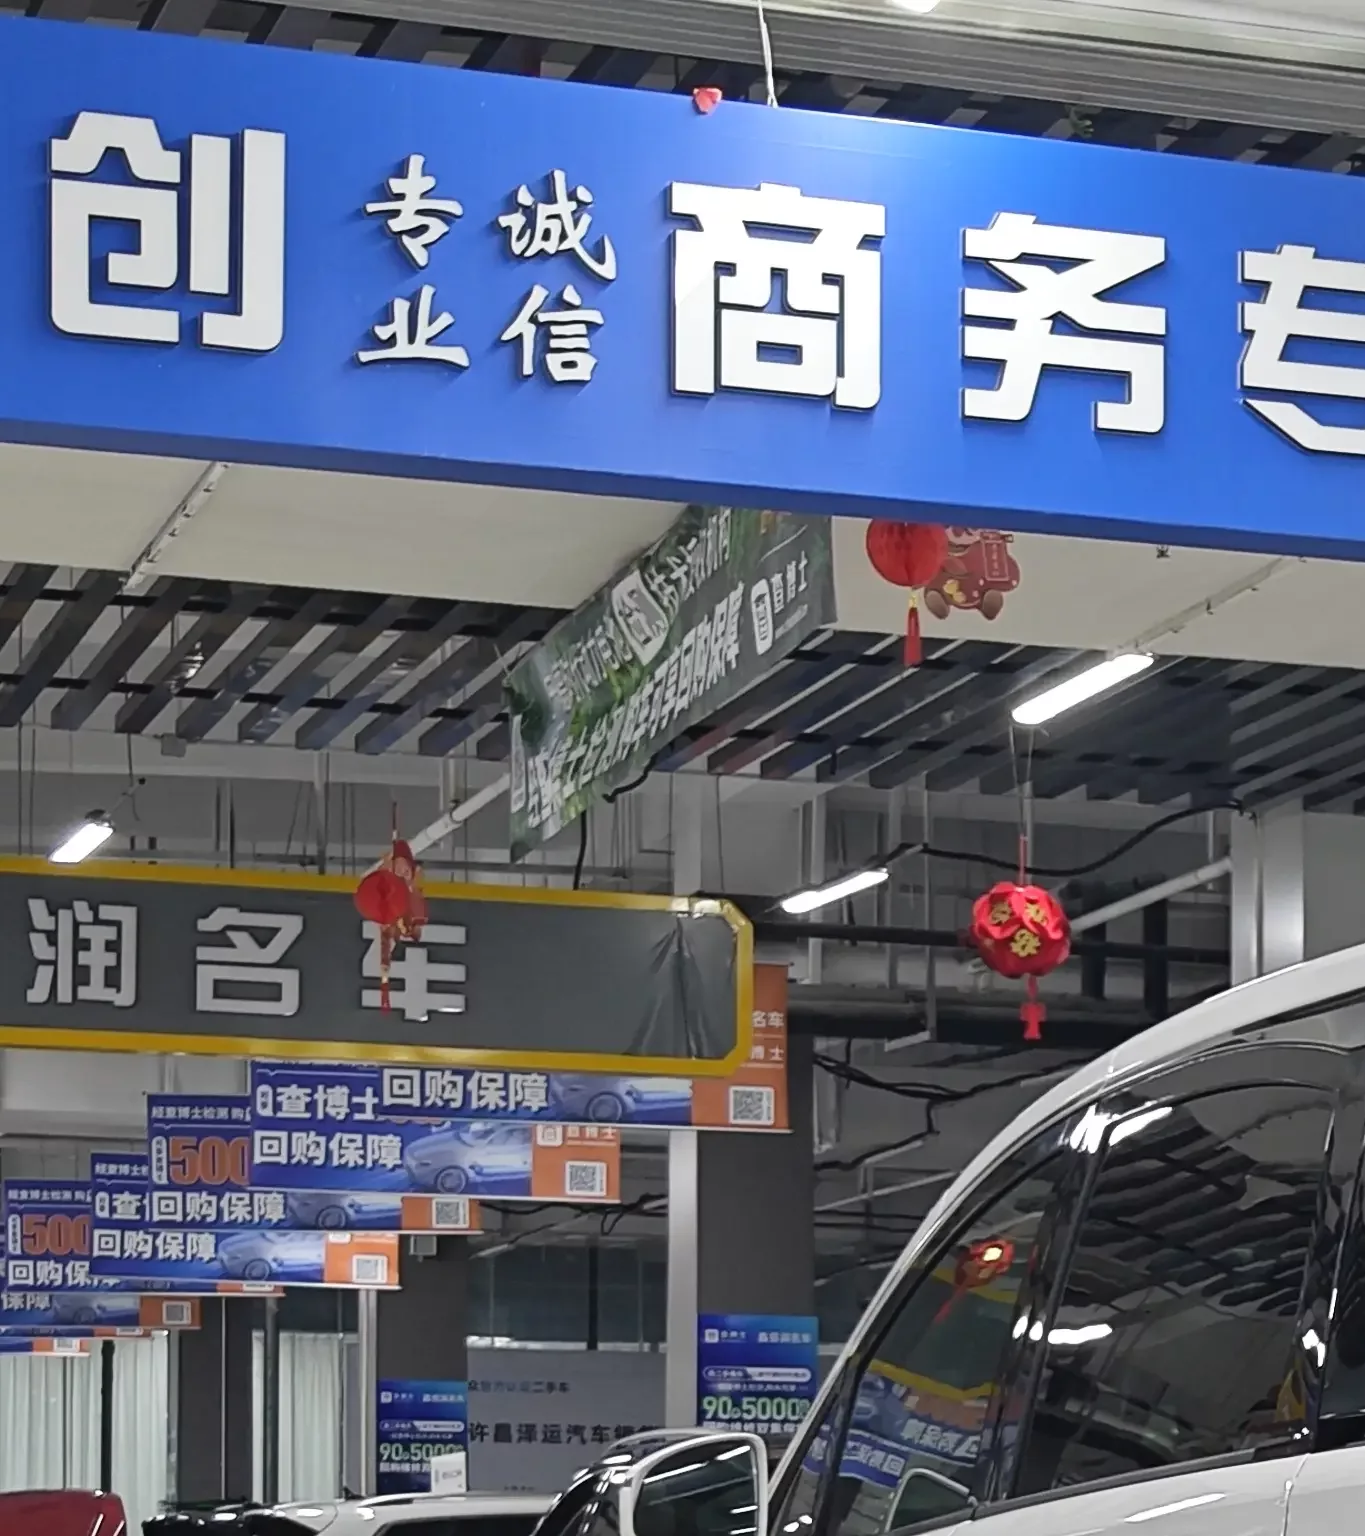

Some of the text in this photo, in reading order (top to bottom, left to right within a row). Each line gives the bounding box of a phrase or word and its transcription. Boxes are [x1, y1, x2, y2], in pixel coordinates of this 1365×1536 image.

[48, 110, 287, 353] 创
[25, 895, 468, 1022] 润名车
[276, 1083, 380, 1121] 查博士
[381, 1067, 551, 1112] 回购保障
[253, 1129, 403, 1170] 回购保障
[151, 1191, 286, 1225] 回购保障
[92, 1228, 217, 1263] 回购保障
